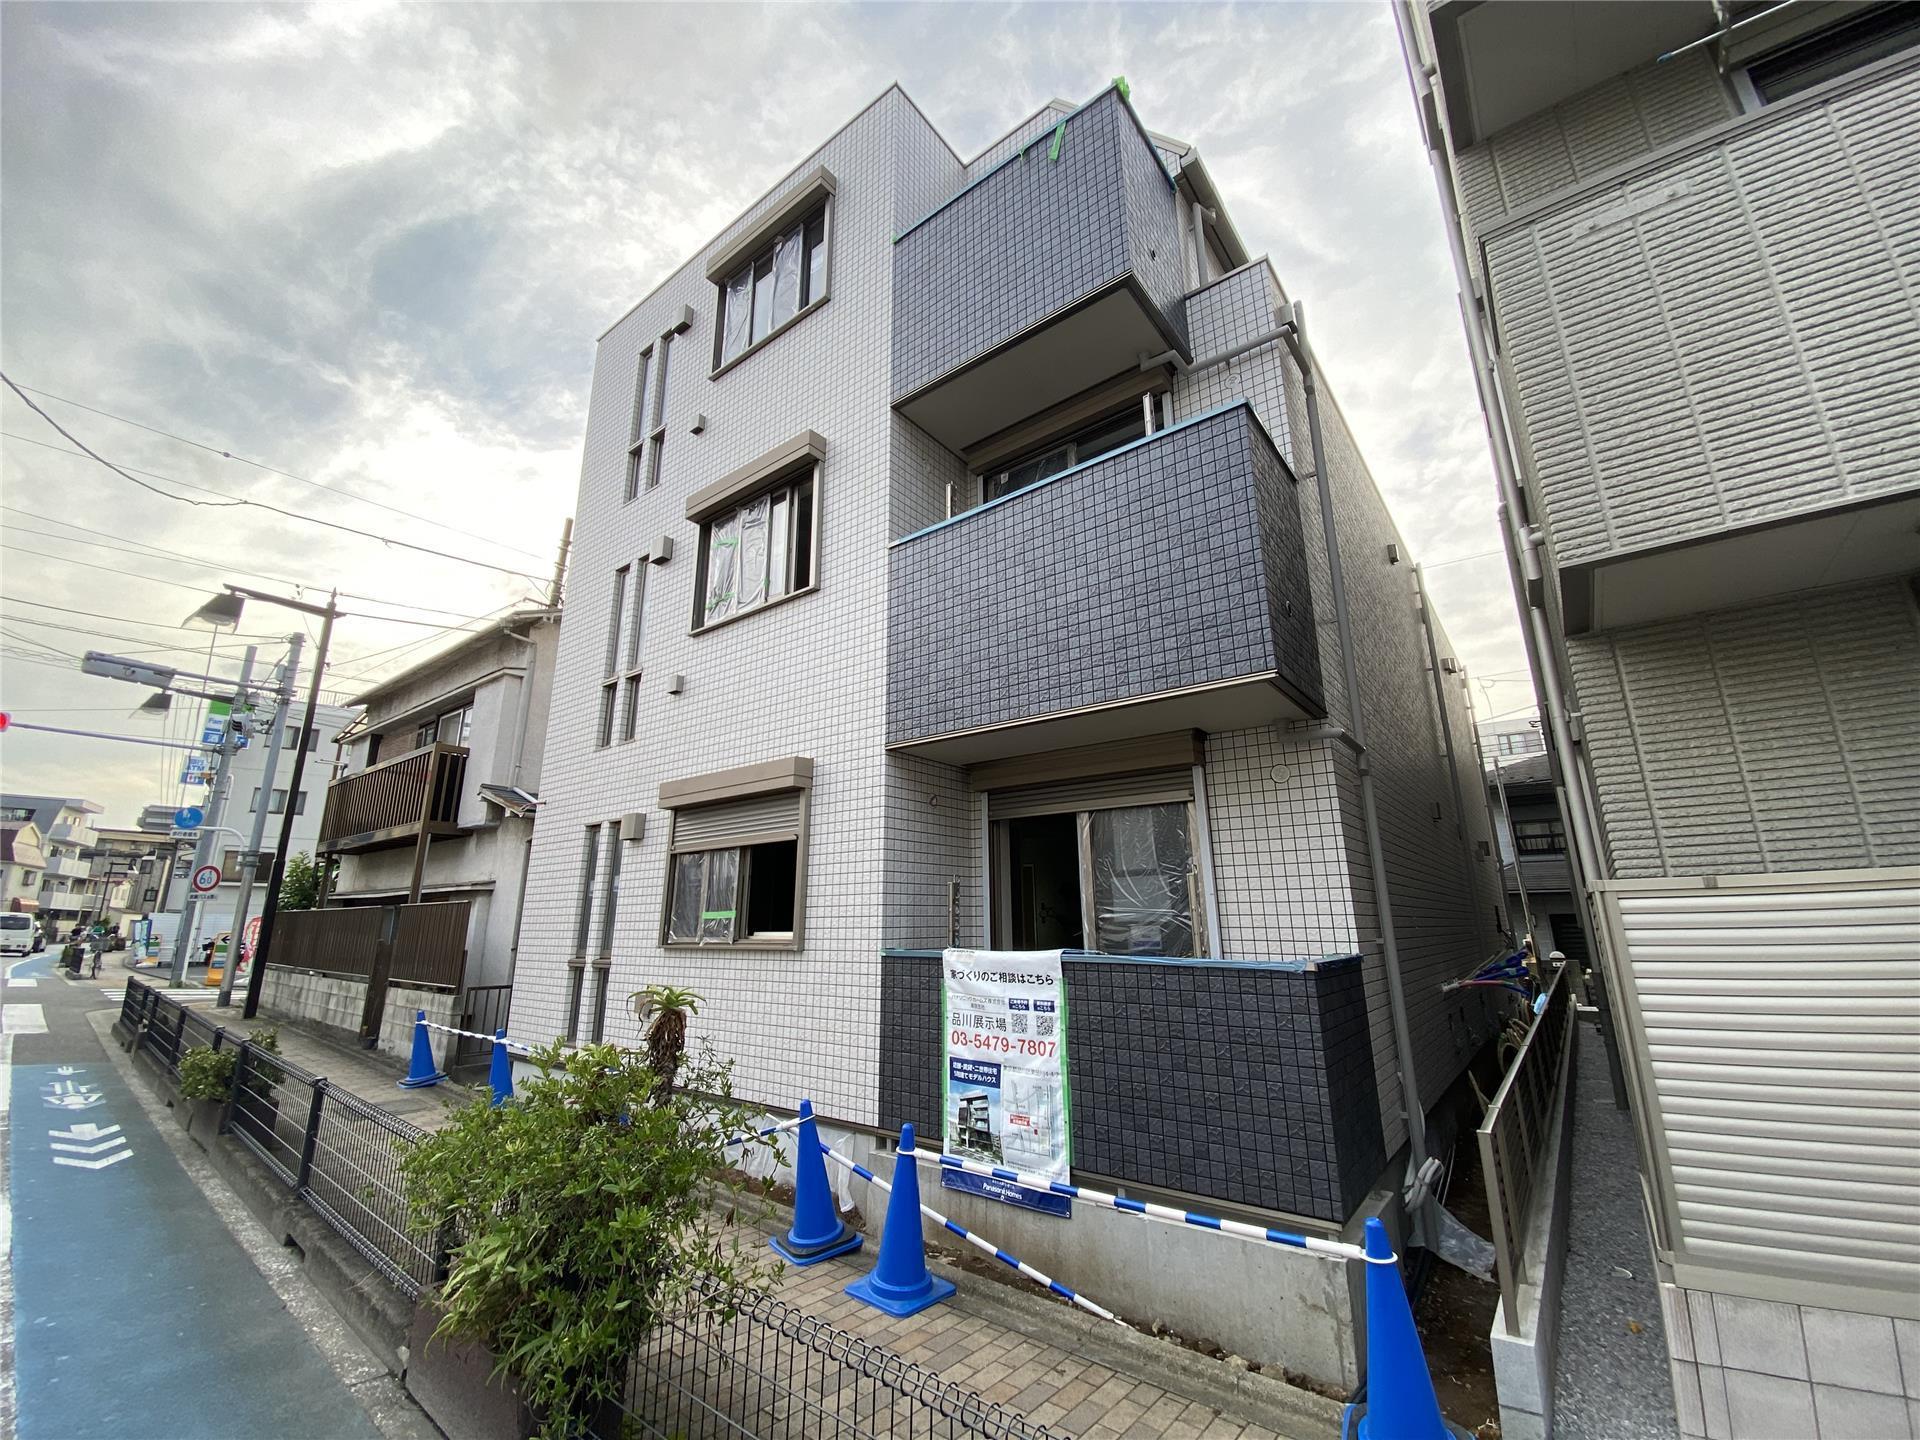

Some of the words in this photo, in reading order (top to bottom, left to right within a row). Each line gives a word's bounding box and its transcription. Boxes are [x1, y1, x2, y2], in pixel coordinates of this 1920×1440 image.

[950, 969, 1054, 985] 家づくりのご相談はこちら
[952, 1012, 1007, 1032] 品川展示場
[952, 1030, 1056, 1057] 03-5479-7807
[1005, 1188, 1023, 1200] Homes
